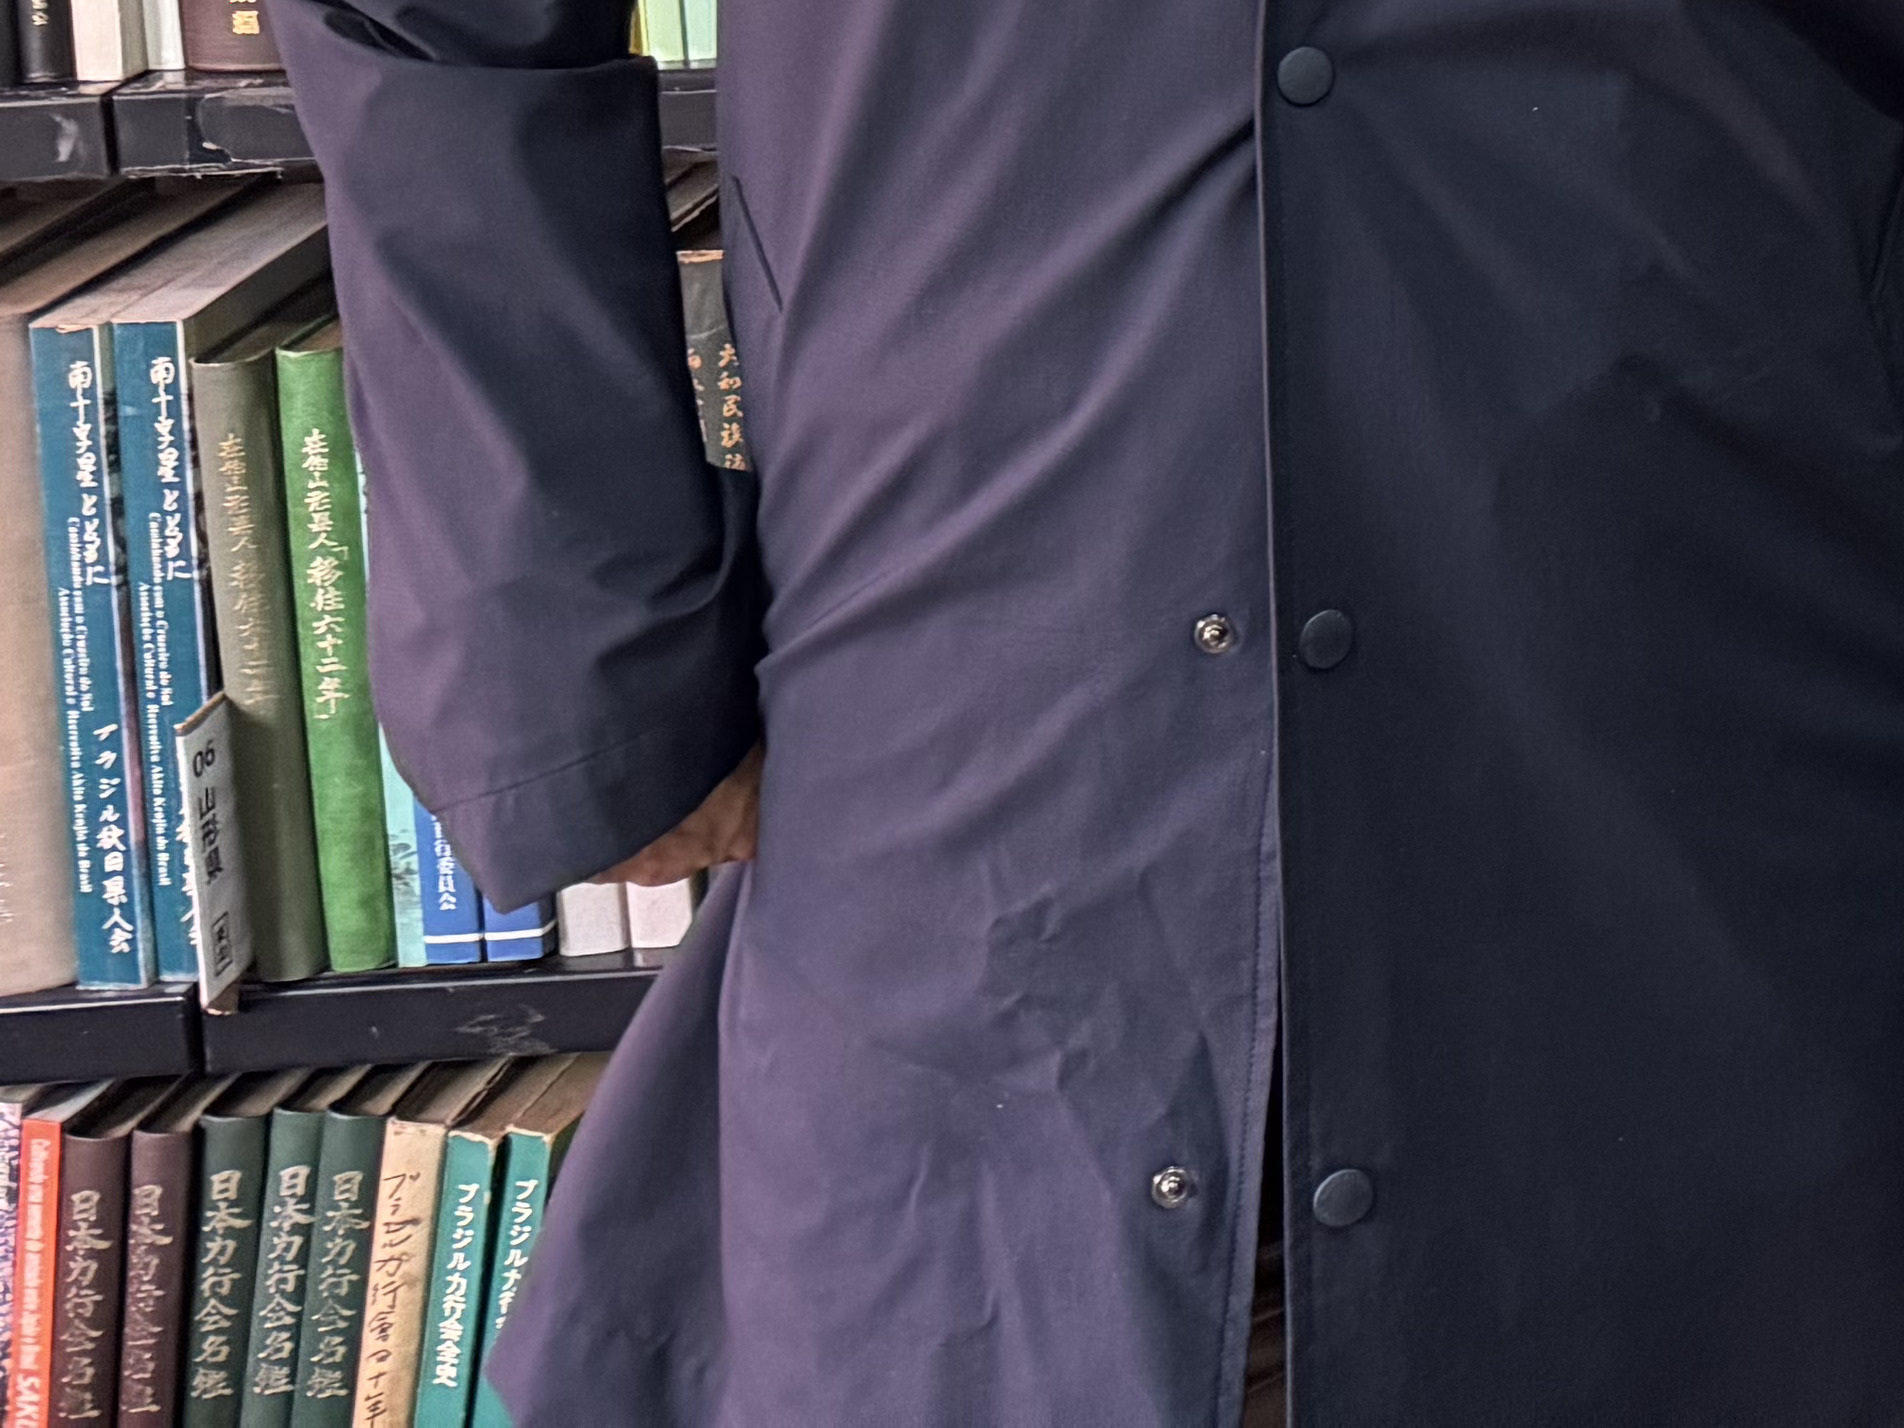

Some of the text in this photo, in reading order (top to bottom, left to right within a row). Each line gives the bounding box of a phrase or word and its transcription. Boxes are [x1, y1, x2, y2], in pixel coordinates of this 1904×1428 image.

[67, 359, 110, 587] 南十字星とともに
[150, 356, 193, 582] 南十字星とともに
[191, 1170, 252, 1399] 日本力行会名鑑
[254, 1166, 318, 1395] 日本力行会名鑑
[306, 1172, 370, 1399] 日本力行会名鑑
[432, 1184, 479, 1388] ブラジル力行会全史
